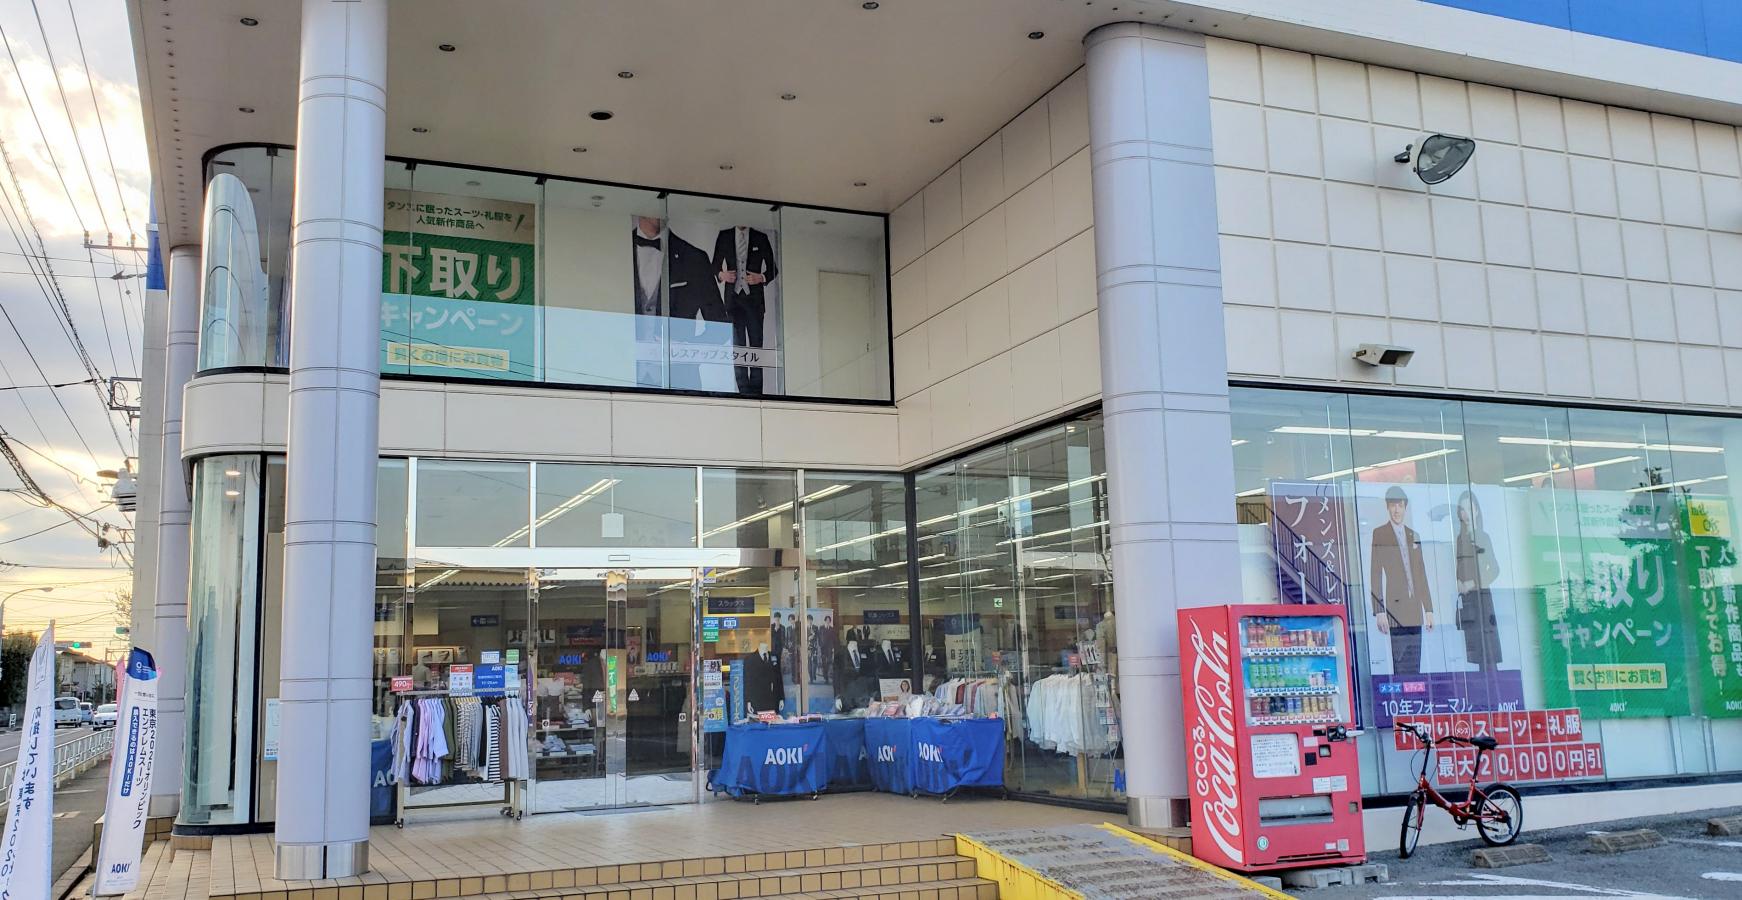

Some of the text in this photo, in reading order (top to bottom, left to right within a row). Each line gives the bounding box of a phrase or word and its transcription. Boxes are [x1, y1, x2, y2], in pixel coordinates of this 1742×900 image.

[382, 243, 521, 300] 下取り
[381, 301, 523, 336] キャンペーン
[1552, 617, 1672, 648] キャンペーン
[764, 746, 804, 766] AOKI
